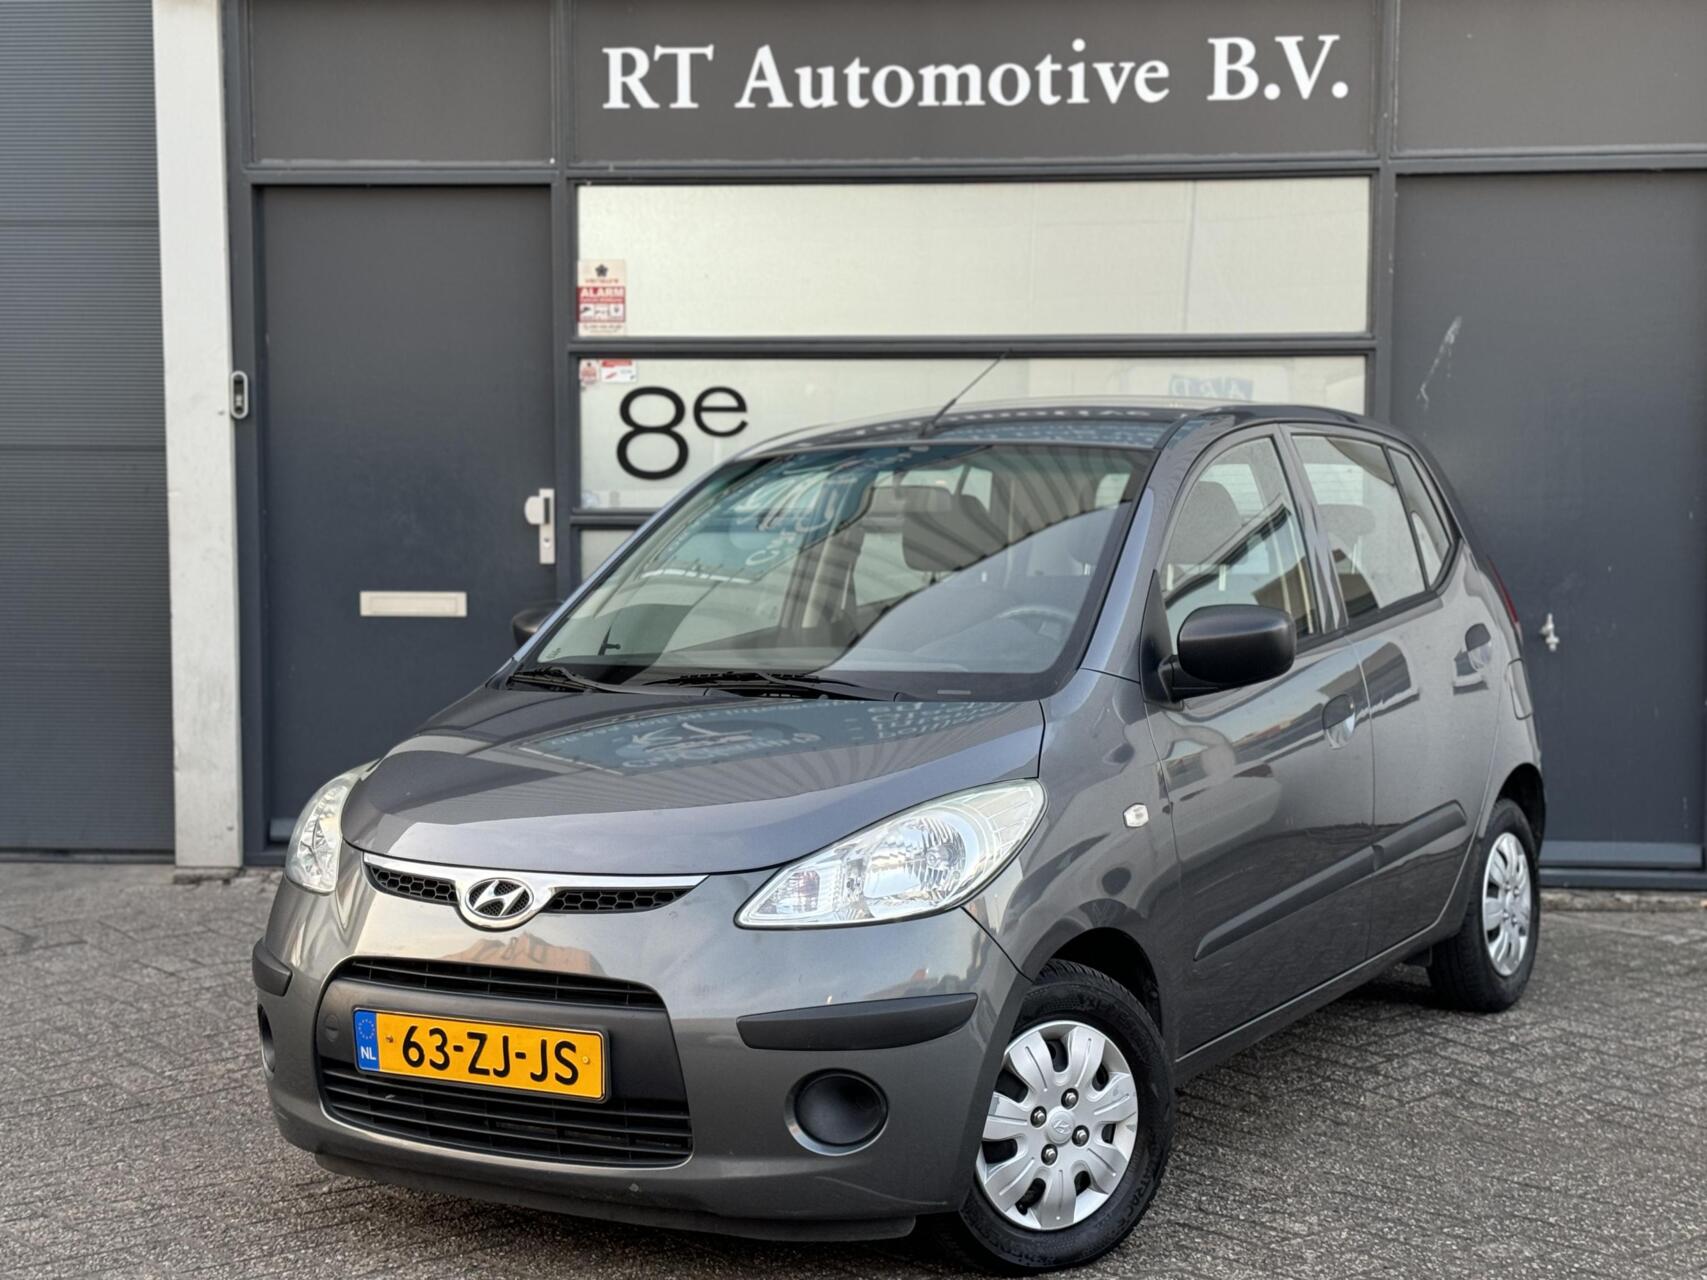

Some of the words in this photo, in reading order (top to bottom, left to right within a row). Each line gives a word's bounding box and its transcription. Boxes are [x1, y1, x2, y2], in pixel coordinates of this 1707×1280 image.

[602, 44, 714, 110] RT
[735, 38, 1169, 110] Automotive
[1207, 34, 1349, 103] B.V.
[581, 288, 624, 298] ALARM
[617, 386, 748, 480] 8e
[360, 1046, 376, 1061] NL
[402, 1025, 579, 1085] 63-ZJ-JS
